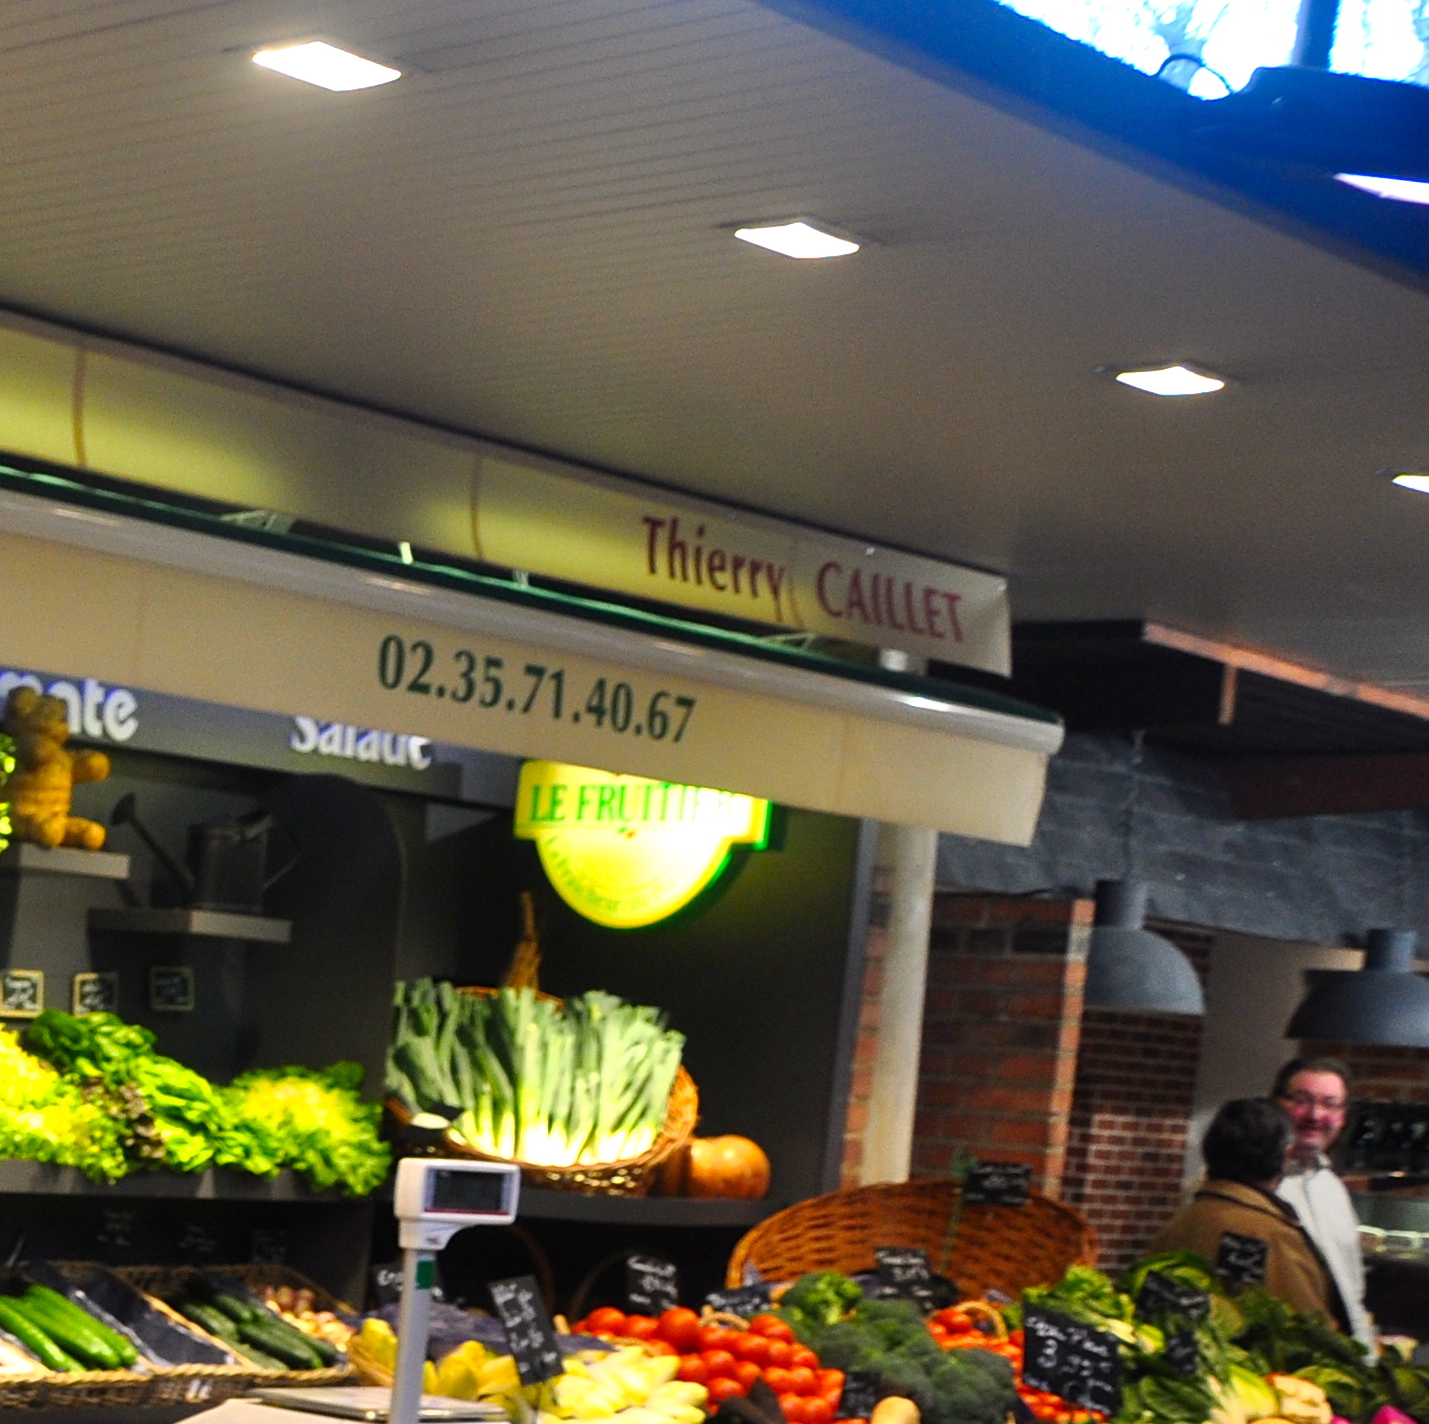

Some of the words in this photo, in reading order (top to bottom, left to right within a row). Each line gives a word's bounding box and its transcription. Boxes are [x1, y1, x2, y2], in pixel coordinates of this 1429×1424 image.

[643, 516, 785, 623] Thierry
[816, 562, 964, 645] CAILLET
[378, 634, 696, 744] 02.35.71.40.67
[531, 783, 568, 822] LE
